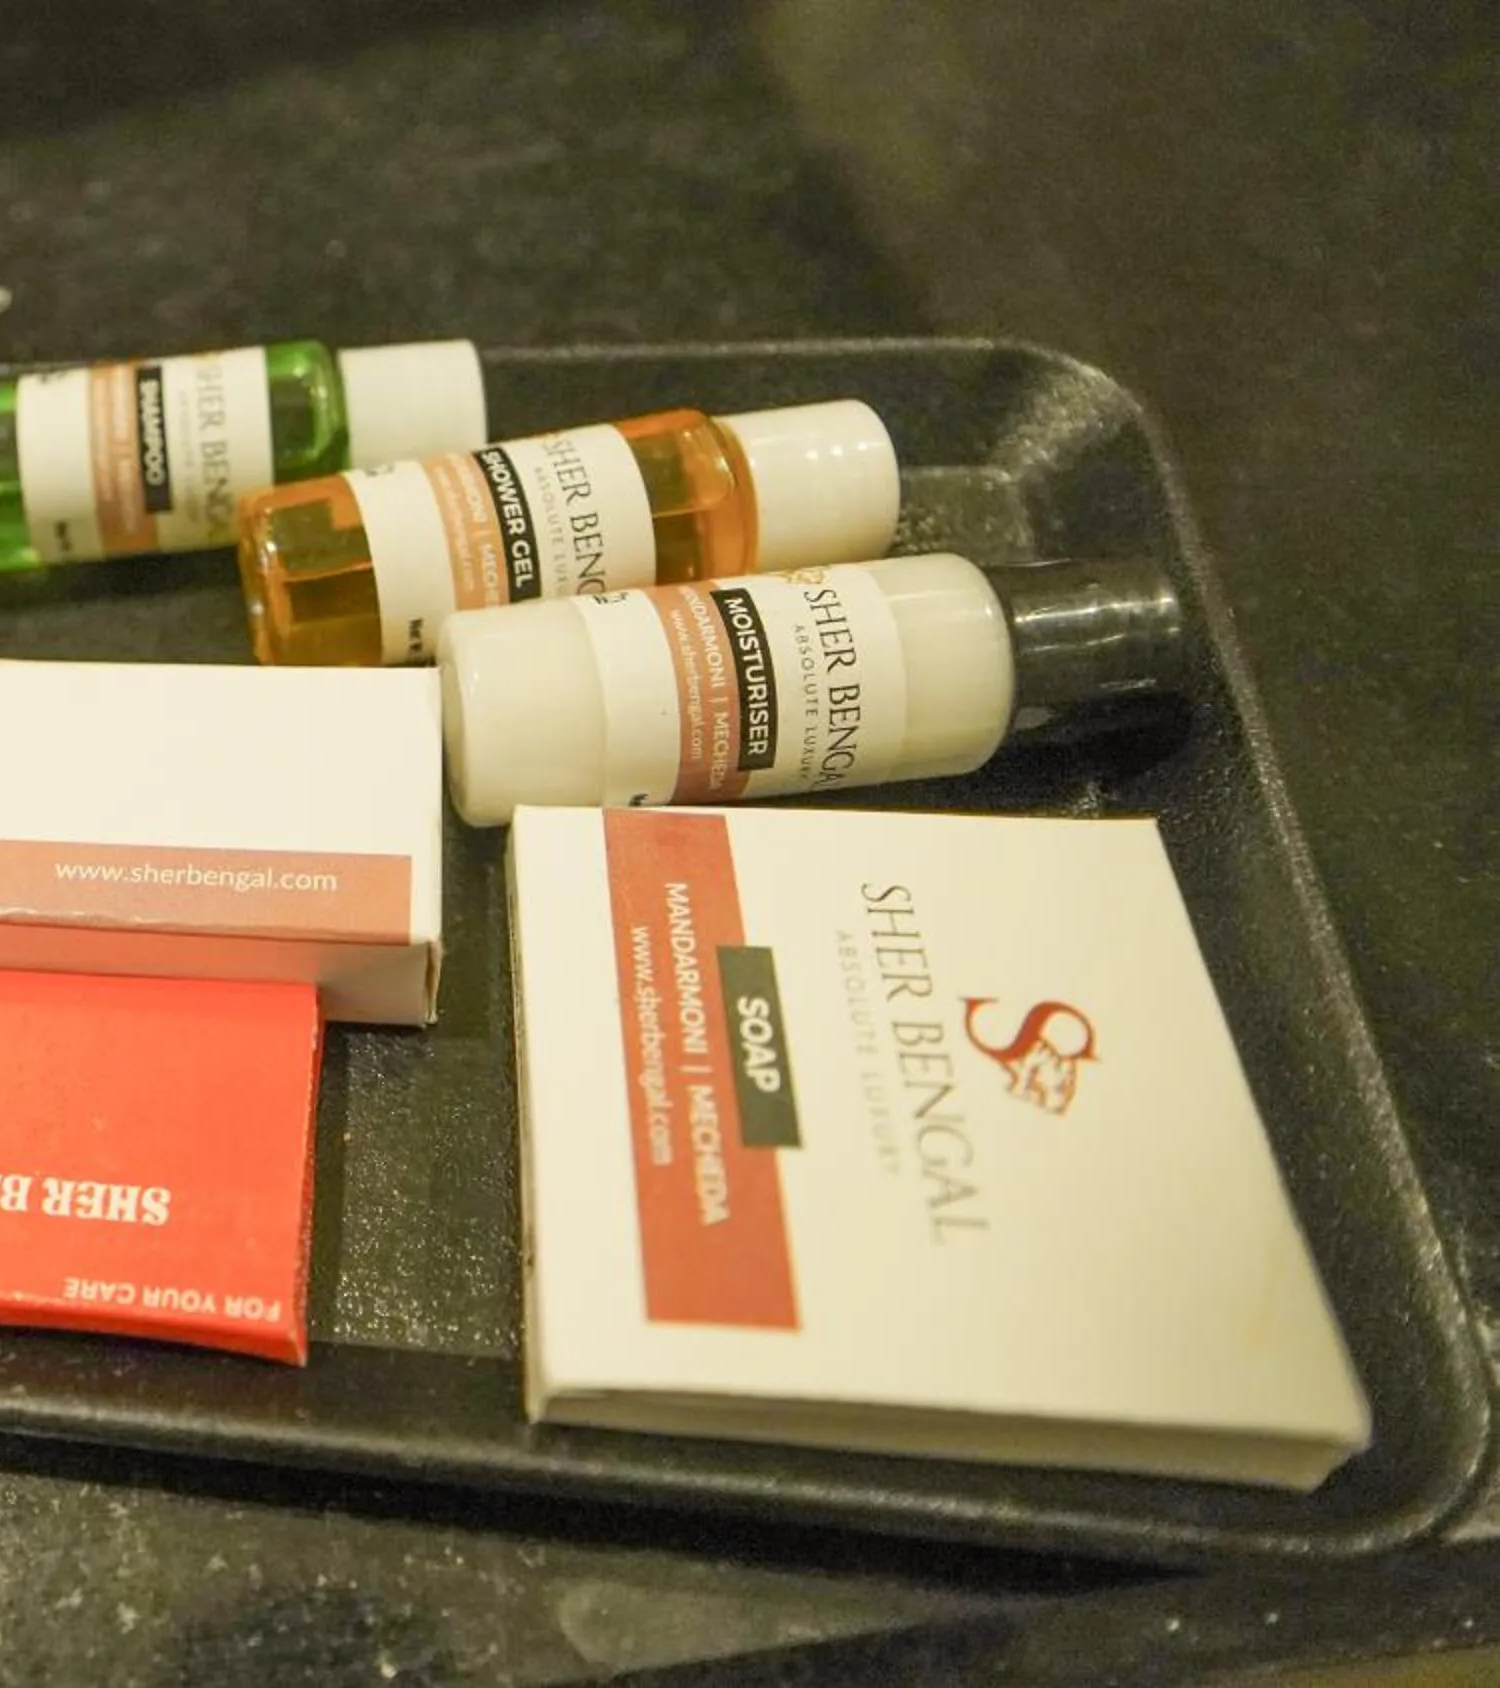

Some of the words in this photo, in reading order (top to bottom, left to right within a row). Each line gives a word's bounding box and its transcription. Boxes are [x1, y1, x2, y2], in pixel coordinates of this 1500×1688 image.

[139, 379, 166, 486] SHAMPOO
[542, 438, 591, 509] SHER
[480, 450, 526, 536] SHOWER
[510, 540, 534, 589] GEL
[725, 595, 771, 757] MOISTURISER
[794, 623, 819, 718] ABSOLUTE
[803, 588, 858, 674] SHER
[54, 862, 338, 893] www.sherbengal.com
[664, 881, 710, 1056] MANDARMONI
[835, 929, 880, 1057] ABSOLUTE
[860, 881, 934, 1003] SHER
[630, 925, 674, 1169] www.sherbengal.com
[736, 995, 782, 1096] SOAP
[686, 1084, 732, 1228] MECHEDA
[890, 1018, 991, 1245] BENGAL
[41, 1175, 173, 1227] SHER
[63, 1276, 137, 1305] CARE
[142, 1285, 217, 1314] YOUR
[224, 1294, 283, 1323] FOR
